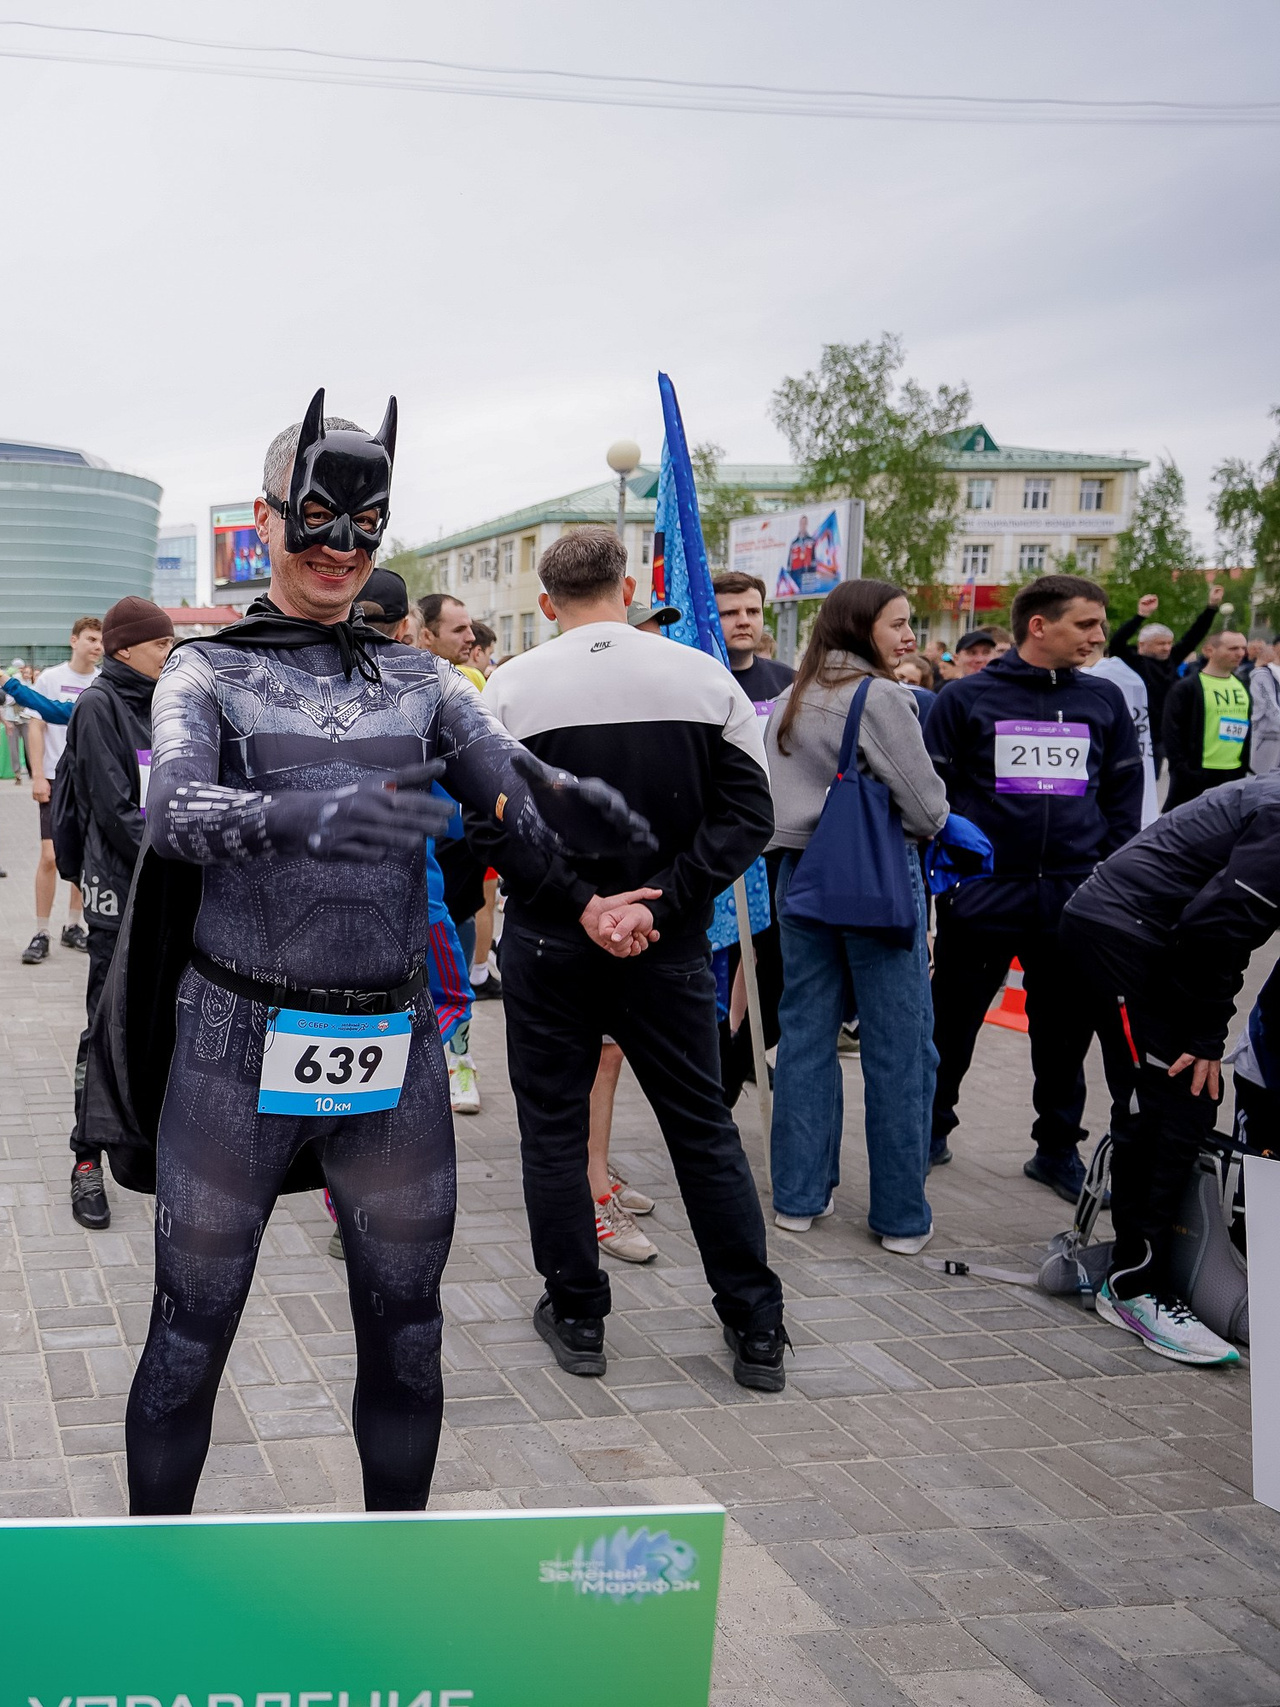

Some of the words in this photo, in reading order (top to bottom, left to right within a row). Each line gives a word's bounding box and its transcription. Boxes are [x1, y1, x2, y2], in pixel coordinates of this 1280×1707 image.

[1011, 745, 1080, 767] 2159
[308, 1021, 329, 1029] СБЕР
[294, 1044, 384, 1085] 639
